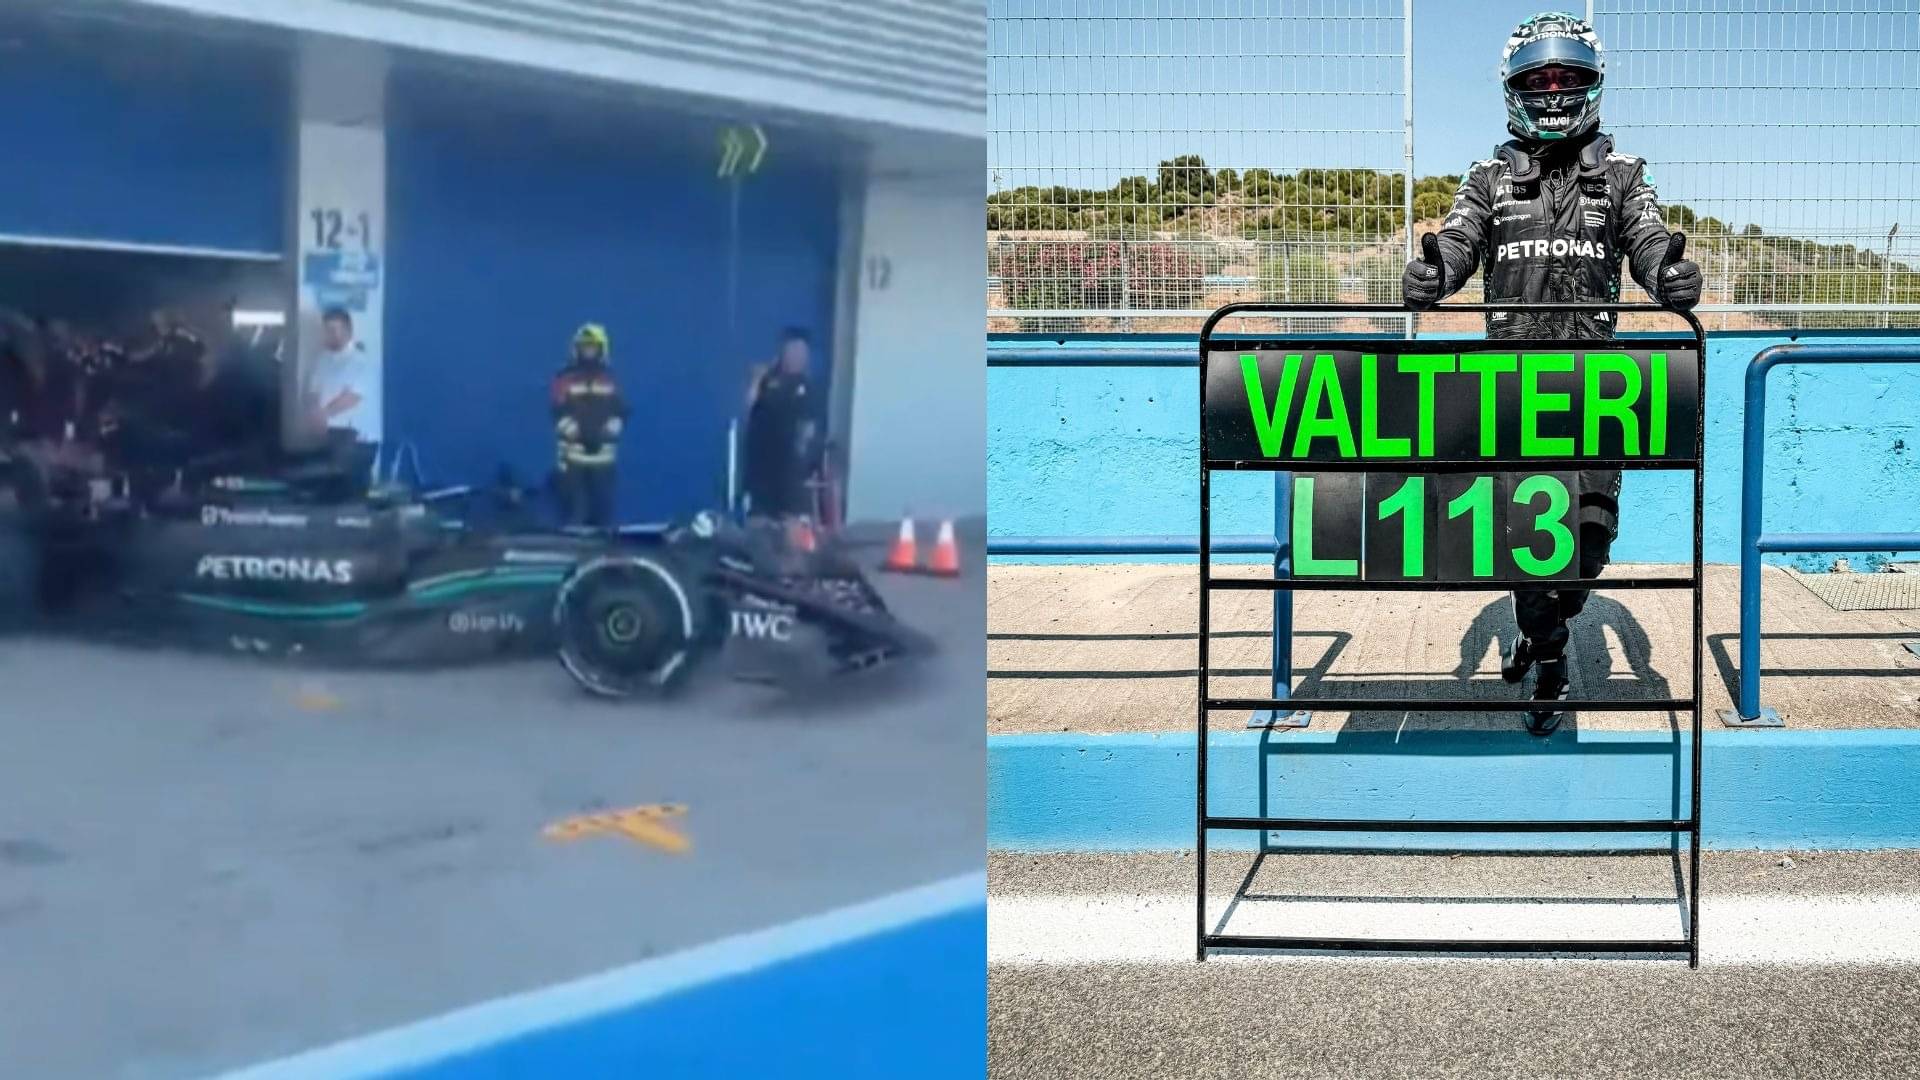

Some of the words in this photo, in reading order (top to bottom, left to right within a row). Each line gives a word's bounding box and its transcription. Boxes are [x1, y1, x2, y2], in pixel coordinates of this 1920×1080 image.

[1539, 113, 1570, 126] nuvei
[1504, 184, 1527, 194] UBS
[1580, 183, 1611, 195] NEOS
[309, 208, 370, 249] 12-1
[1497, 239, 1605, 262] PETRONAS
[1239, 352, 1669, 458] VALTTERI
[196, 555, 353, 583] PETRONAS
[730, 611, 794, 642] IWC
